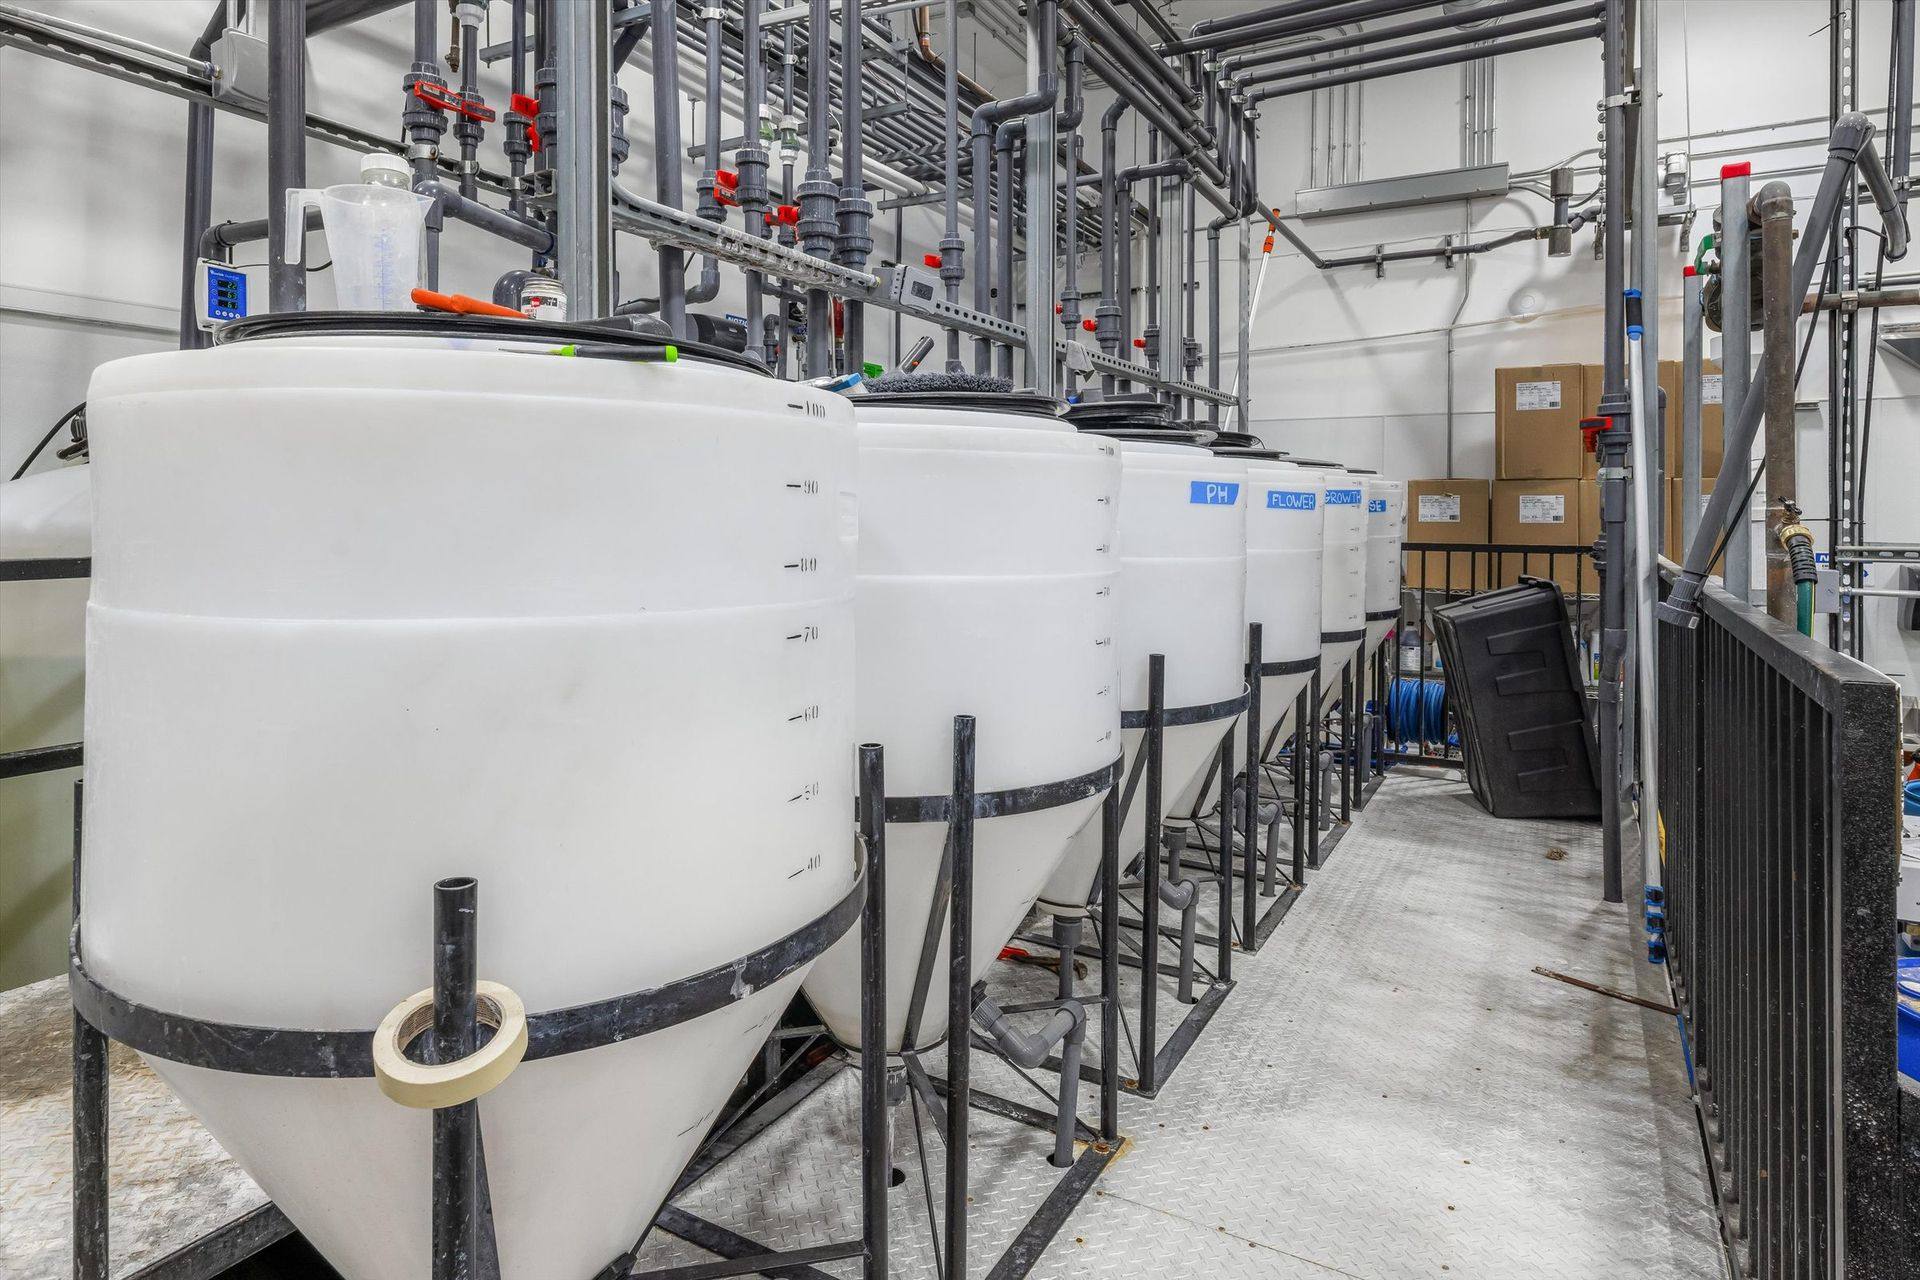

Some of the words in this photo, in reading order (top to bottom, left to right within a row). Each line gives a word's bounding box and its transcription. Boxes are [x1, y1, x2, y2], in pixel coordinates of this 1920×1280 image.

[805, 400, 826, 418] 100
[804, 480, 818, 494] 90
[1206, 484, 1228, 504] PH
[1272, 493, 1314, 510] FLOWER
[1325, 490, 1361, 504] GROWTH
[801, 558, 817, 572] 80
[804, 626, 819, 642] 70
[804, 704, 819, 723] 60
[807, 853, 821, 871] 40
